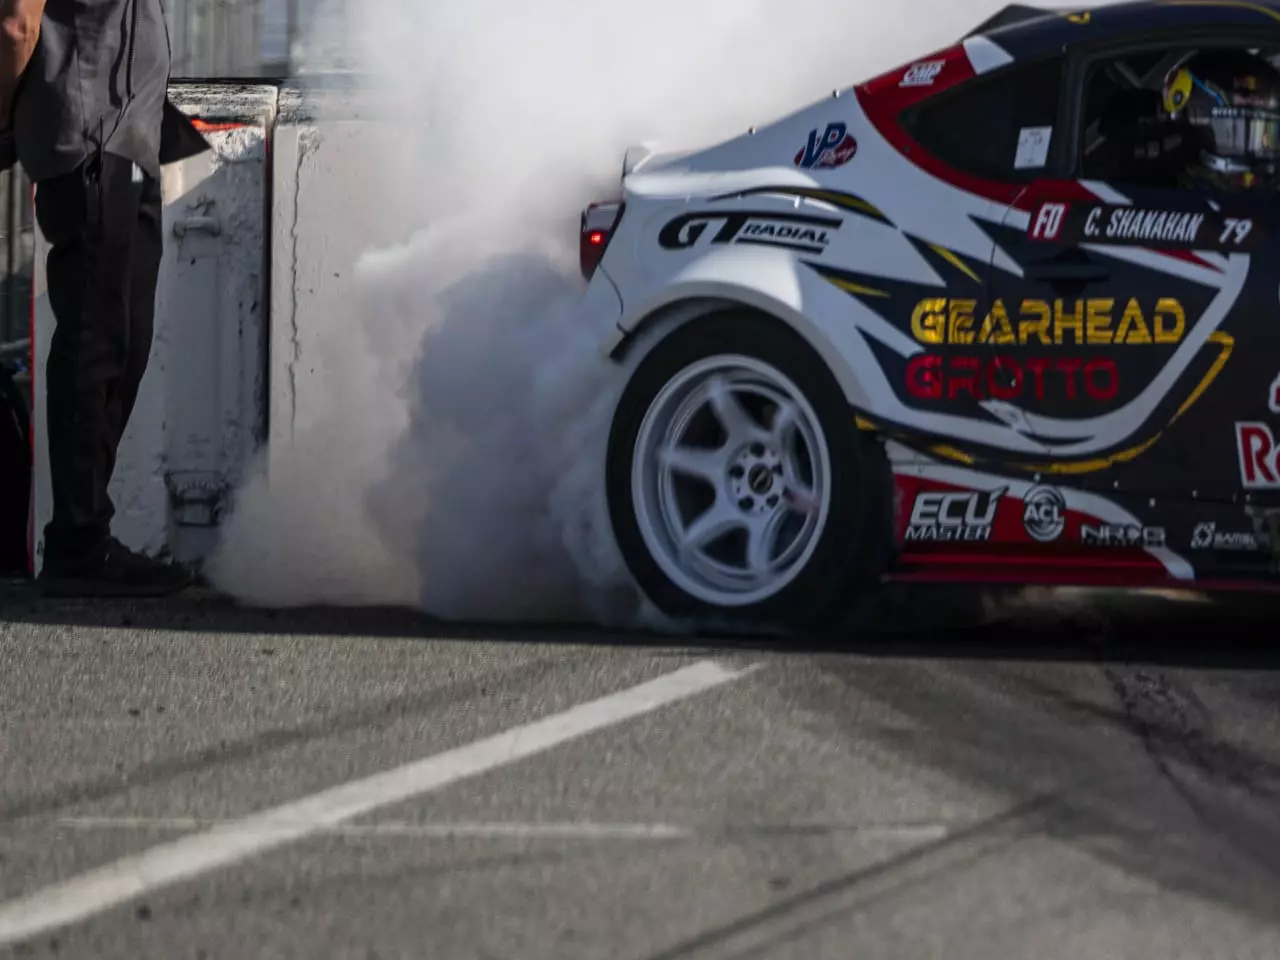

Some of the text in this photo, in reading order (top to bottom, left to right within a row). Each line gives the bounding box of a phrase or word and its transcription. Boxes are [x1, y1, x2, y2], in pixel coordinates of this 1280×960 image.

[799, 122, 847, 169] VP
[742, 223, 830, 245] RADIAL
[1083, 207, 1102, 237] C.
[1106, 208, 1204, 243] SHANAHAN
[1218, 217, 1253, 244] 79
[910, 297, 1186, 345] GEARHEAD
[904, 355, 1121, 400] GROTTO
[910, 490, 1002, 526] ECU
[1023, 502, 1064, 523] ACL
[904, 525, 992, 541] MASTER
